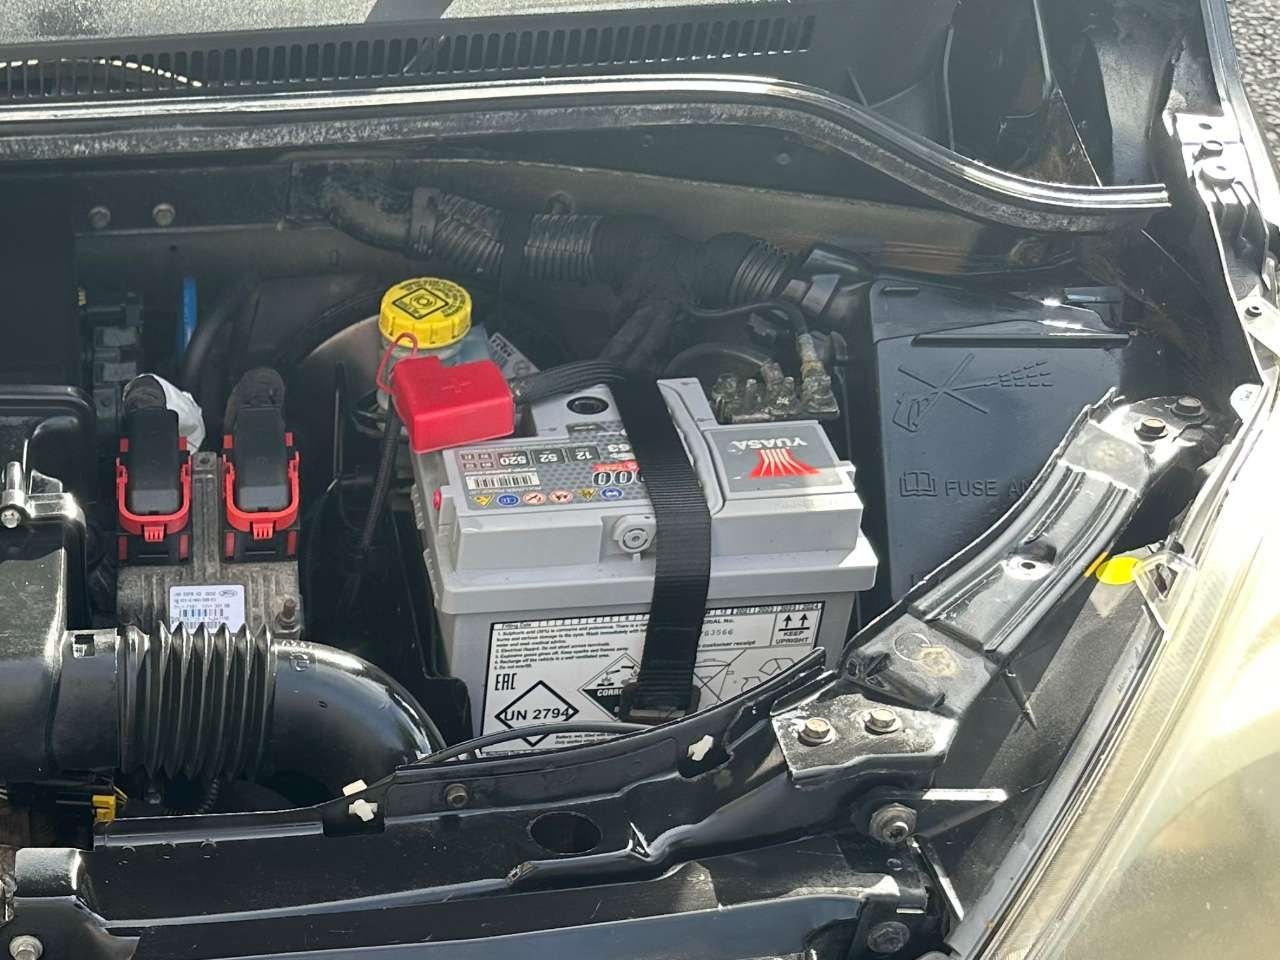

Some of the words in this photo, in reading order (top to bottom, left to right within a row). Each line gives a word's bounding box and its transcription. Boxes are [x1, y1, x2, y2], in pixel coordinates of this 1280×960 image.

[731, 437, 807, 449] YUASA
[500, 456, 526, 466] 520
[539, 453, 557, 462] 52
[576, 451, 593, 460] 12
[945, 479, 1000, 497] FUSE
[504, 709, 528, 721] UN
[532, 708, 570, 721] 2794
